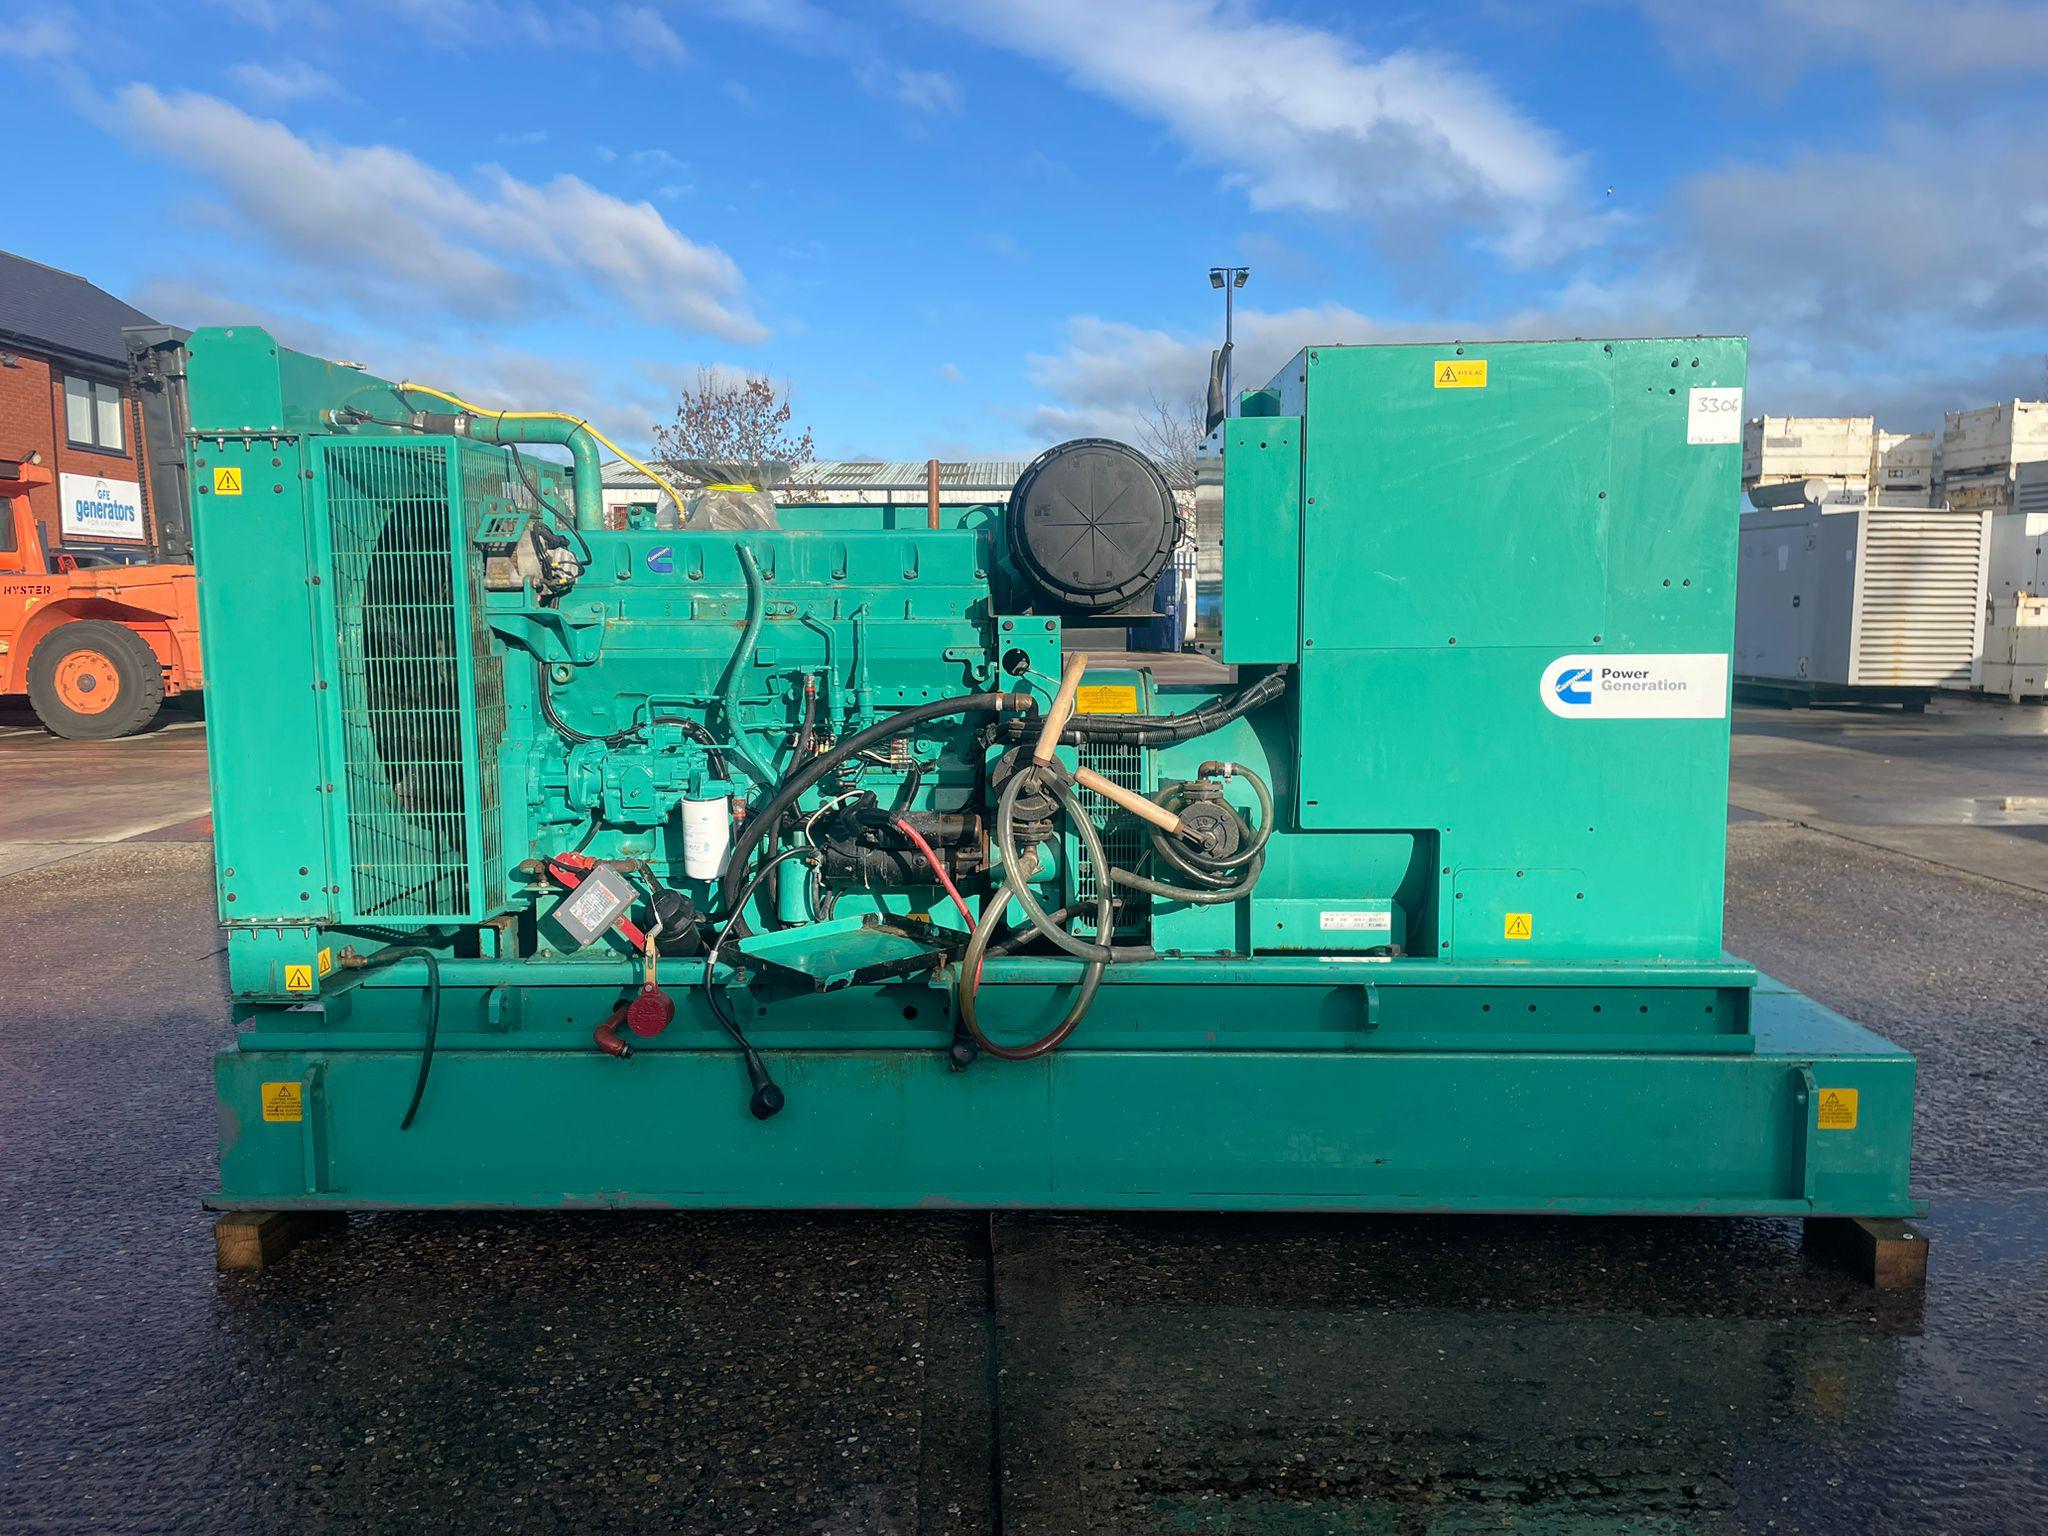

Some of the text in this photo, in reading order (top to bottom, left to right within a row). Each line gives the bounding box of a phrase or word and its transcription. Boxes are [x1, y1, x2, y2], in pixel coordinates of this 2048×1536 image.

[1697, 396, 1740, 413] 3306
[97, 489, 111, 501] GFE
[75, 499, 136, 522] generators
[4, 585, 51, 595] HYSTER
[1555, 667, 1592, 693] Cummins
[1601, 667, 1650, 680] Power
[1601, 679, 1689, 692] Generation
